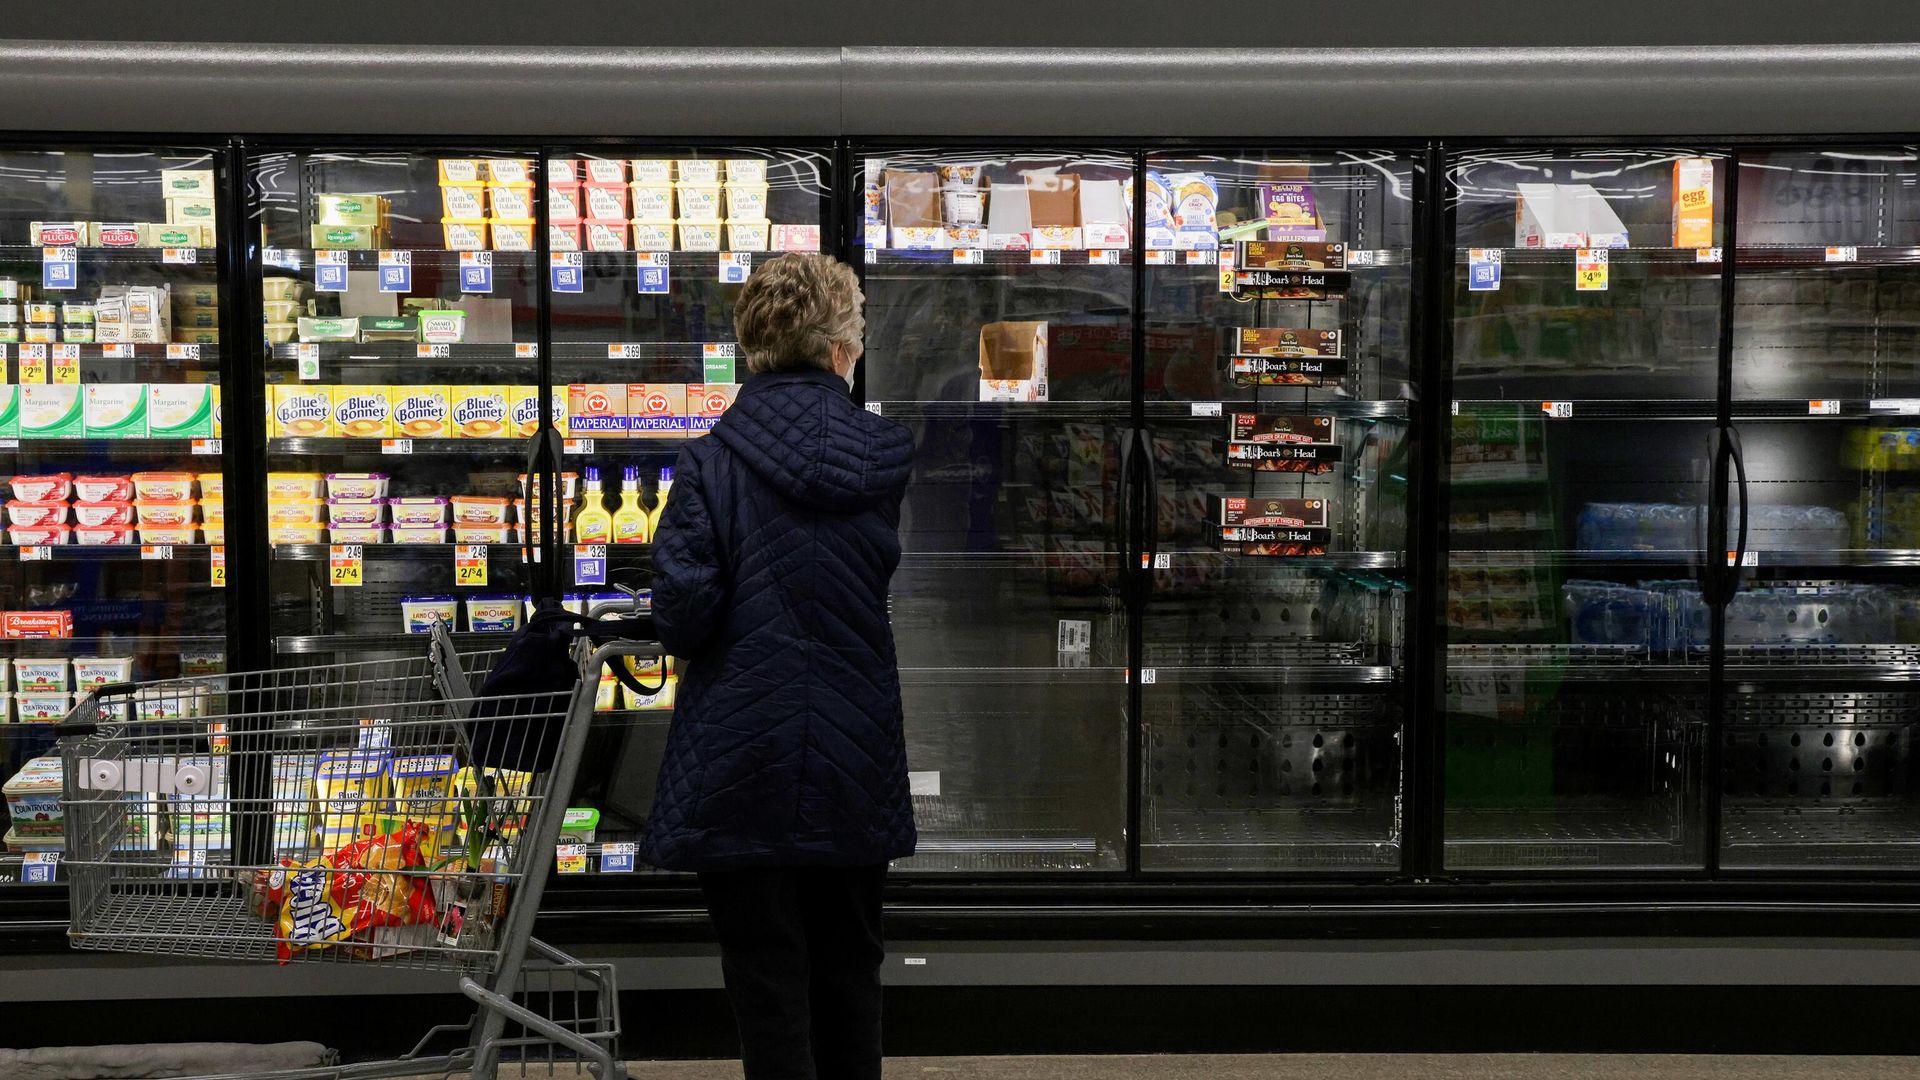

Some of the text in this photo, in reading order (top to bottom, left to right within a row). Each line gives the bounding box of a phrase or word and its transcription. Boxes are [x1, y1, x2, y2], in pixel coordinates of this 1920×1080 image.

[1682, 190, 1706, 203] egg
[1302, 275, 1325, 285] Head
[1300, 362, 1322, 372] Head
[25, 399, 60, 407] Margarine
[90, 398, 123, 406] Margarine
[153, 398, 187, 407] Margarine
[290, 396, 317, 409] Blue
[348, 396, 375, 409] Blue
[407, 397, 433, 409] Blue
[467, 397, 493, 410] Blue
[282, 407, 327, 421] Bonnet
[340, 407, 385, 421] Bonnet
[399, 407, 444, 422] Bonnet
[459, 407, 503, 422] Bonnet
[571, 417, 625, 428] IMPERIAL
[631, 417, 685, 428] IMPERIAL
[1294, 449, 1316, 458] Head
[1253, 531, 1311, 541] Boar's Head
[81, 670, 118, 678] COUNTRY CROCK
[14, 804, 43, 814] COUNTRY
